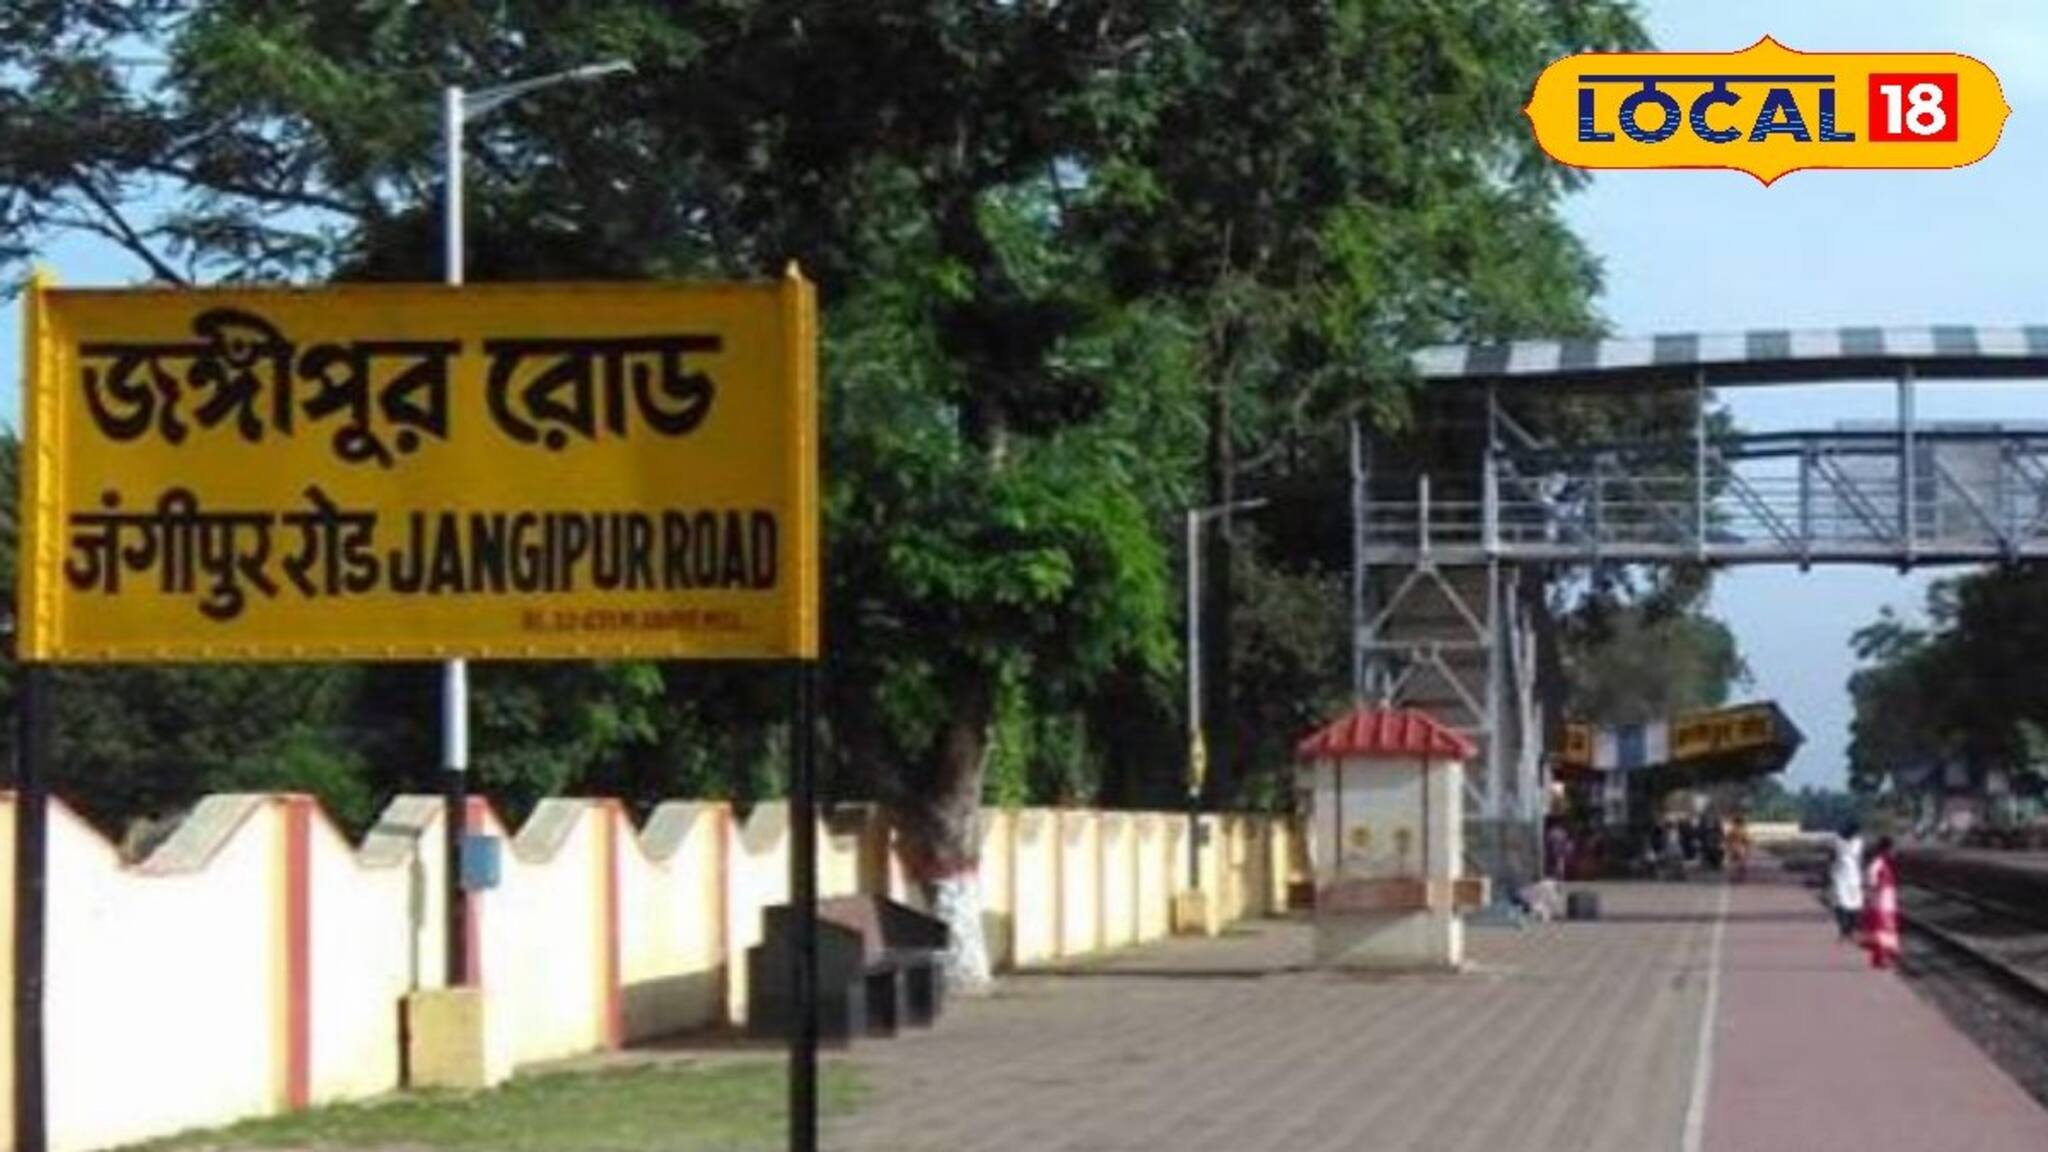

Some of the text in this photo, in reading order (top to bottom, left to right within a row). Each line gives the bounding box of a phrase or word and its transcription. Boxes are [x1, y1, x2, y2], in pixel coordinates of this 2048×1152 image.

[483, 334, 723, 451] রোড
[64, 484, 380, 621] जंगीपुर रोड
[388, 509, 779, 593] JANGIPUR ROAD
